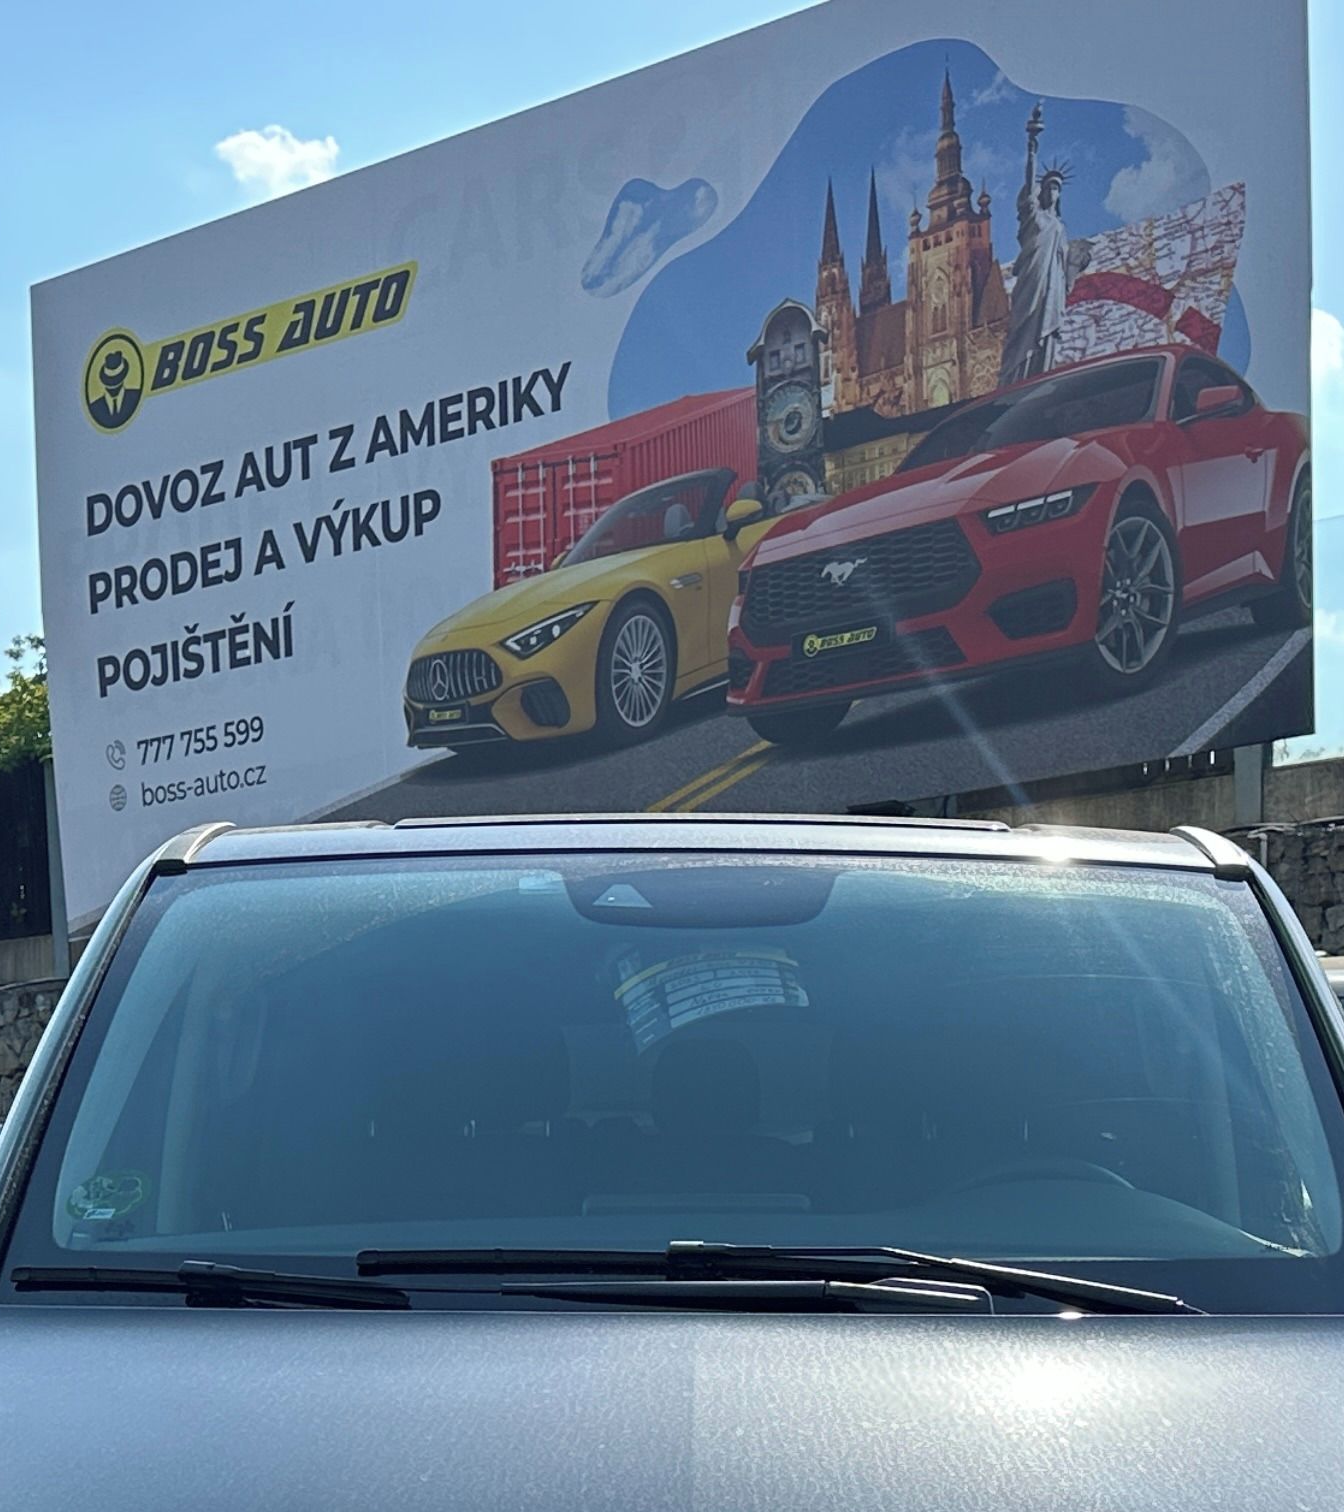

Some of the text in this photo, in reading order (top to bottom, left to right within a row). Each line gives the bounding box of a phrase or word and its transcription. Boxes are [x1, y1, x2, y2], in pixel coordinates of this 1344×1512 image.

[150, 269, 411, 391] BOSS AUTO
[85, 360, 572, 537] DOVOZ AUT Z AMERIKY
[88, 488, 442, 615] PRODEJ A VÝKUP
[96, 600, 297, 699] POJIŠTĚNÍ
[136, 714, 265, 766] 777 755 599
[140, 764, 268, 808] boss-auto.cz
